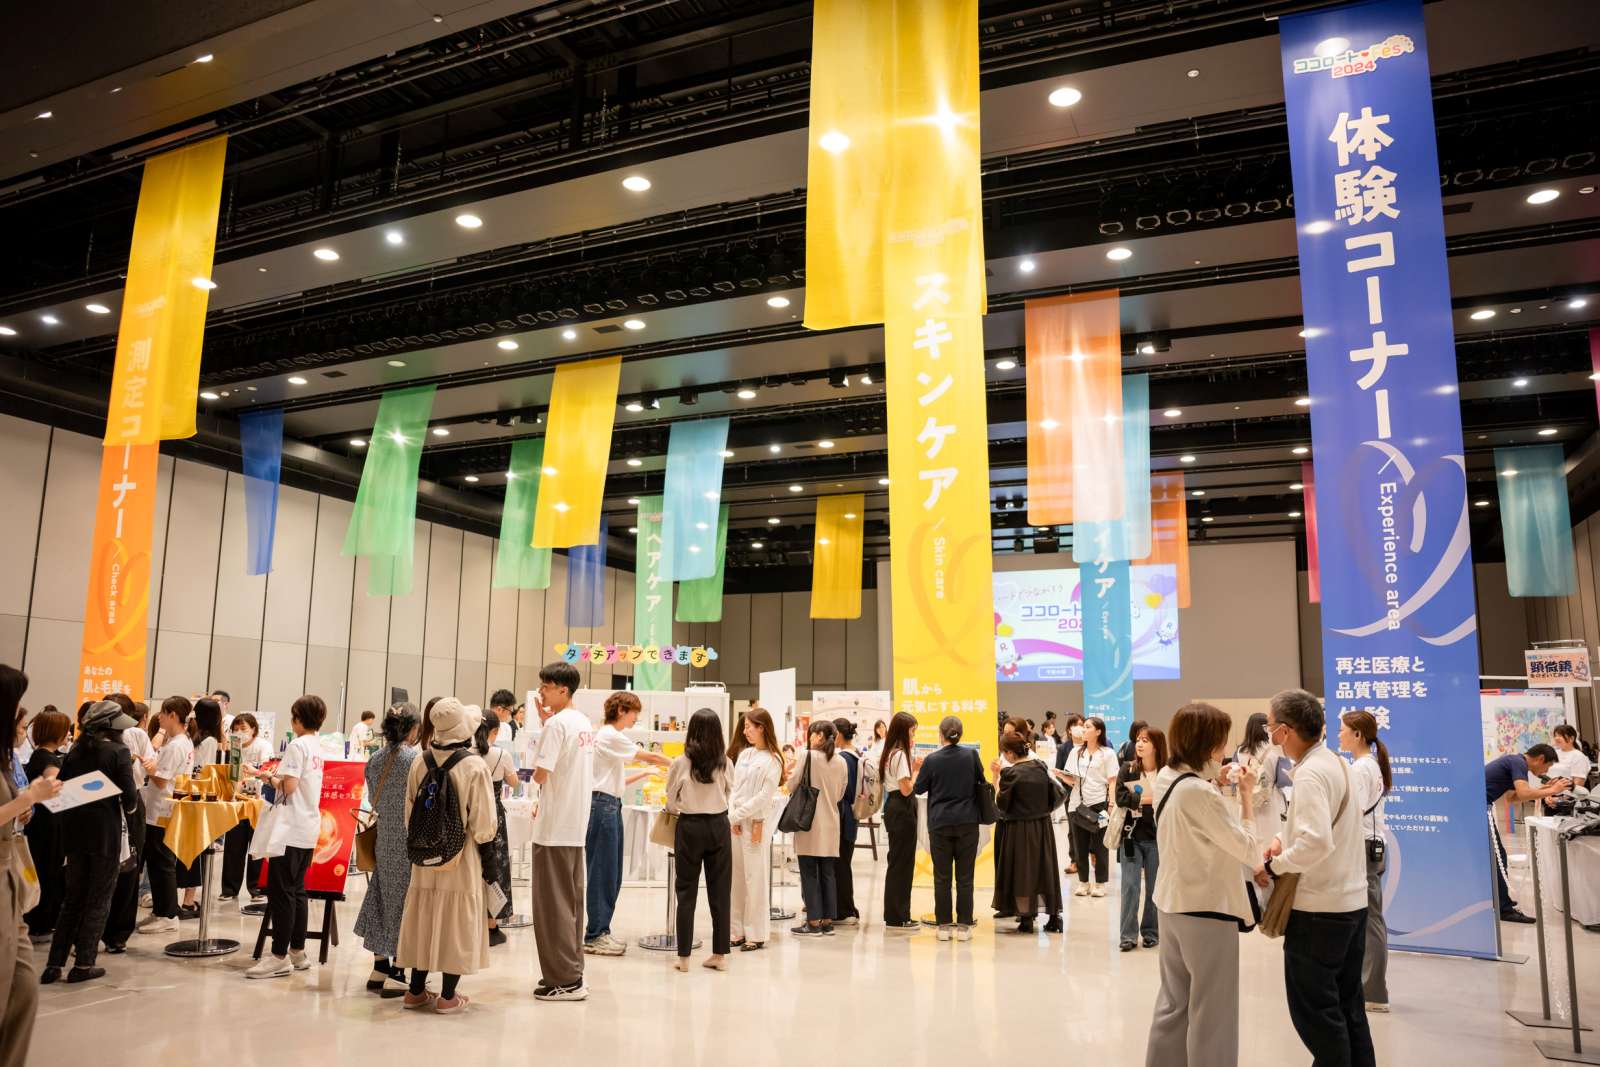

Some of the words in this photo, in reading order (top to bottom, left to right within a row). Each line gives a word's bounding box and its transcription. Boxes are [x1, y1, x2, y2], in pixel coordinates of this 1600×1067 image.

[1333, 61, 1375, 77] 2024
[1328, 106, 1409, 440] 体験コーナー
[912, 272, 959, 511] スキンケア
[1379, 481, 1401, 584] Experience
[933, 536, 945, 569] Skin
[109, 563, 121, 597] Check
[645, 533, 663, 613] ヘアケア
[934, 571, 945, 600] care
[1021, 603, 1082, 618] ココロート
[1386, 589, 1401, 631] area
[565, 648, 705, 664] タッチアップできます
[1335, 656, 1425, 676] 再生医療と
[1530, 659, 1573, 673] 顕微鏡
[1335, 680, 1428, 700] 品質管理を
[901, 699, 987, 713] 元気にする科学
